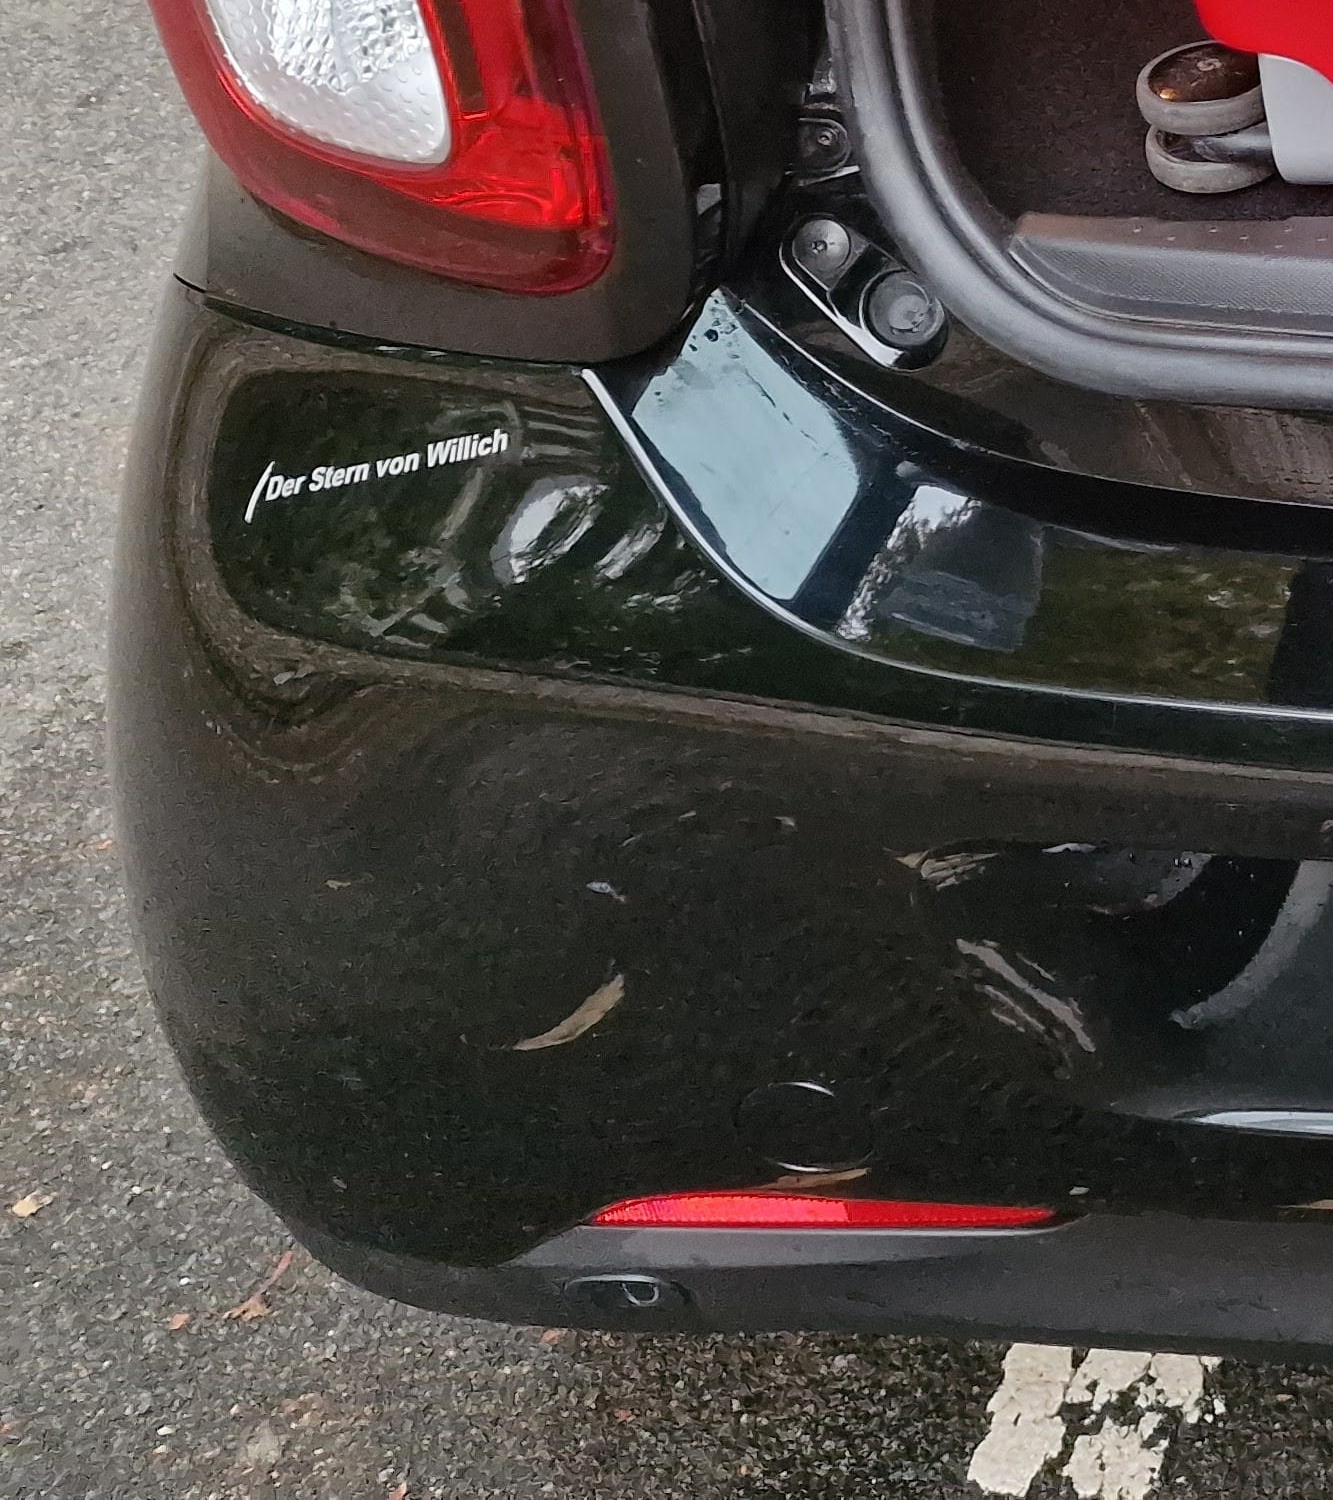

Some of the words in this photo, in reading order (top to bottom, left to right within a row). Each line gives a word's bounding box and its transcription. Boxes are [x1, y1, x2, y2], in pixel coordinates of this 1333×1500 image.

[264, 475, 307, 502] Der
[309, 462, 369, 492] Stern
[376, 452, 419, 480] von
[426, 429, 508, 468] Willich
